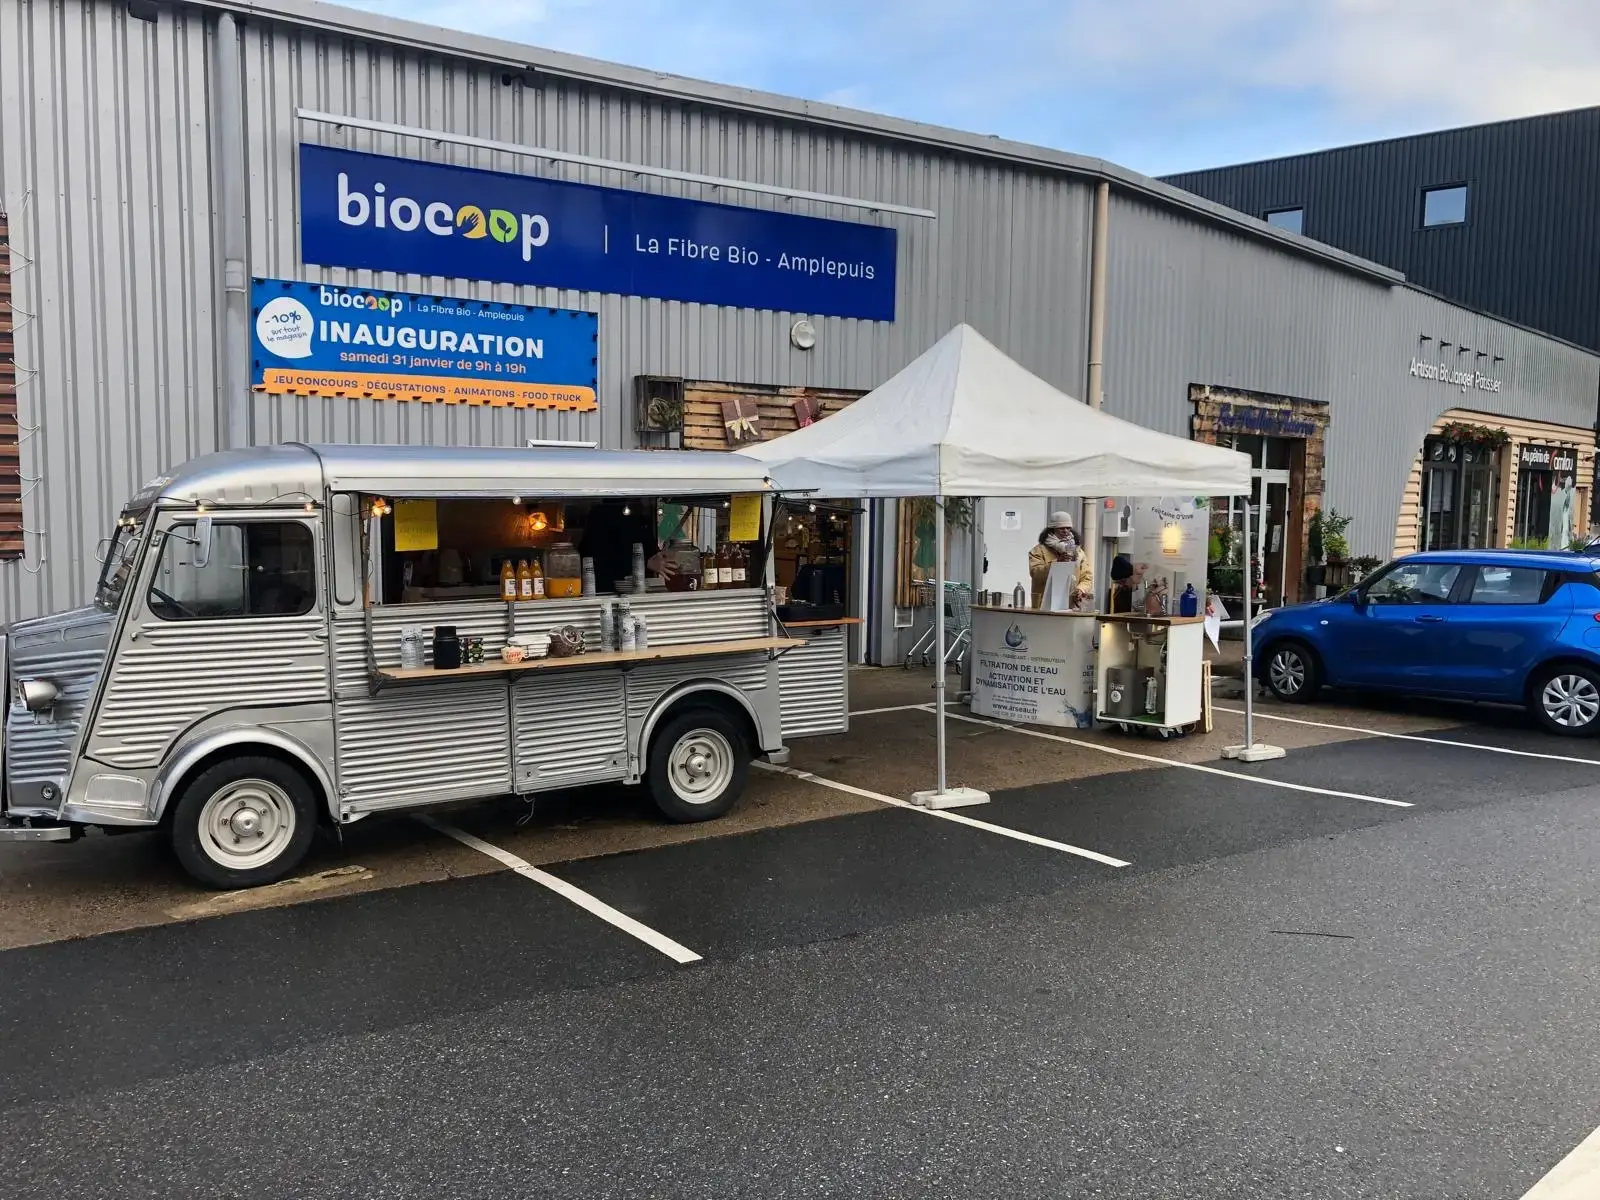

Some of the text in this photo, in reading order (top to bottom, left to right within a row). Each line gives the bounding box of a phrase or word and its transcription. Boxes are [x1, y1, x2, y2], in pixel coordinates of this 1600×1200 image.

[338, 172, 549, 262] biocoop
[636, 234, 659, 253] La
[668, 238, 720, 261] Fibre
[728, 246, 759, 266] Bio
[778, 252, 875, 279] Amplepuis
[320, 285, 403, 318] biocoop
[417, 303, 429, 313] La
[431, 304, 454, 315] Fibre
[456, 308, 471, 316] Bio
[478, 310, 525, 322] Amplepuis
[319, 320, 544, 358] INAUGURATION
[340, 352, 527, 374] samedi 31 janvier de 9h à 19h
[1410, 356, 1439, 380] Artisan
[273, 375, 582, 402] JEU CONCOURS DÉGUSTATIONS ANIMATIONS FOOD TRUCK
[981, 660, 1058, 675] FILTRATION DE L'EAU
[989, 671, 1031, 684] ACTIVATION
[976, 677, 1066, 695] DYNAMISATION DE L'EAU
